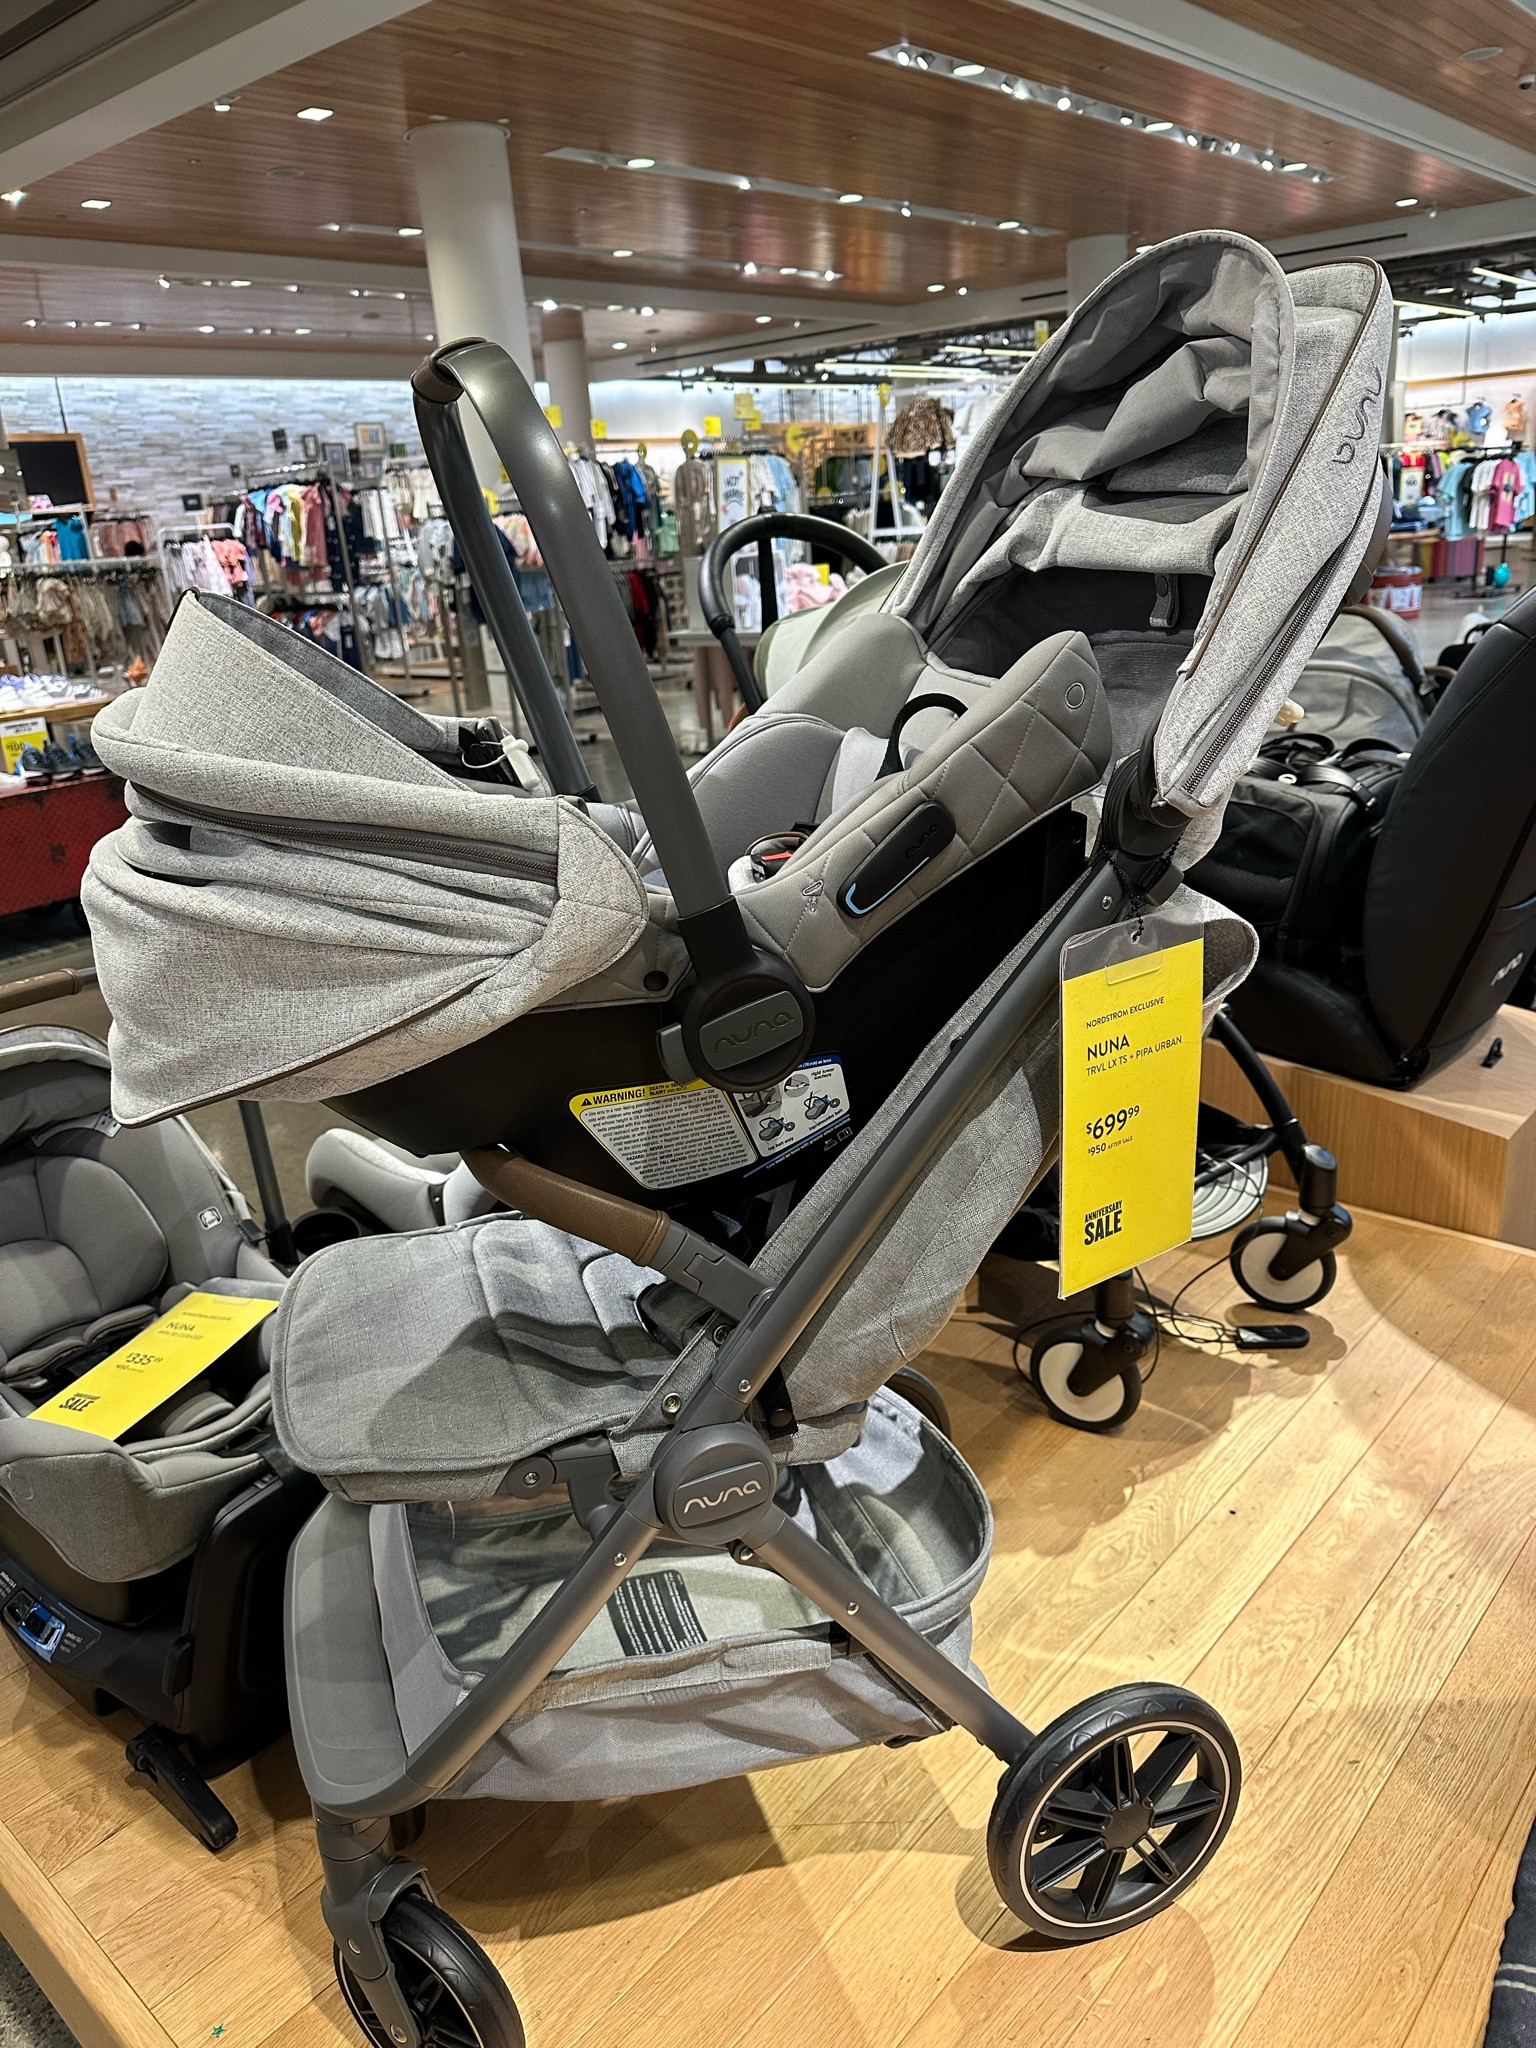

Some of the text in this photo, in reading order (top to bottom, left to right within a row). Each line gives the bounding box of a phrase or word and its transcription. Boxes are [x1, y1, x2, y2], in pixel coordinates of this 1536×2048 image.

[1086, 996, 1164, 1029] NORDSTROM EXCLUSIVE
[714, 1011, 795, 1055] nuna
[1086, 1063, 1106, 1076] TRVL
[1108, 1058, 1117, 1070] LX
[1119, 1055, 1128, 1064] TS
[1136, 1046, 1153, 1059] PIPA
[1155, 1036, 1182, 1052] URBAN
[1087, 1034, 1130, 1061] NUNA
[593, 1088, 645, 1105] WARNING!
[1088, 1142, 1106, 1156] $950
[1108, 1140, 1121, 1150] AFTER
[1085, 1200, 1122, 1223] ANNIVERSARY
[1084, 1209, 1122, 1245] SALE
[166, 1322, 196, 1332] NUNA
[59, 1397, 95, 1411] SALE
[684, 1480, 761, 1514] nuna
